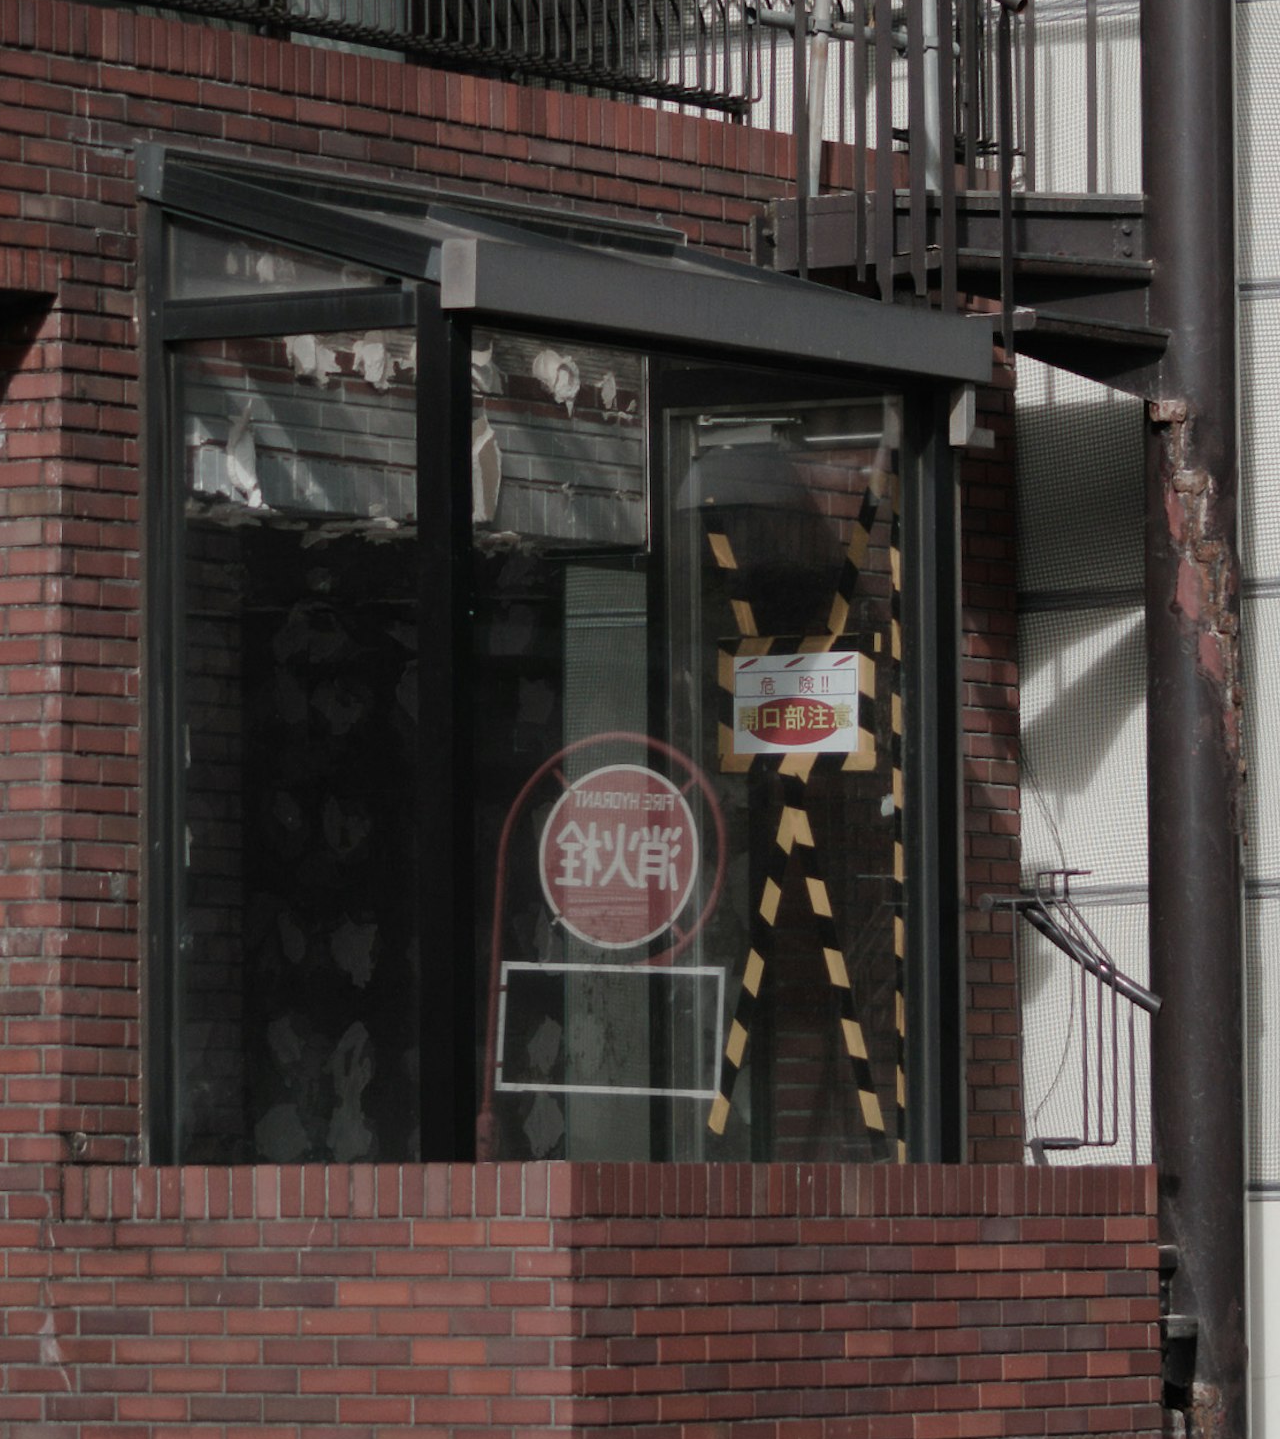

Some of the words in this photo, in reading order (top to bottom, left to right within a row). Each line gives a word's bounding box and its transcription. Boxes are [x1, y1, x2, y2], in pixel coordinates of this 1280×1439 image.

[738, 703, 854, 732] 開口部注意
